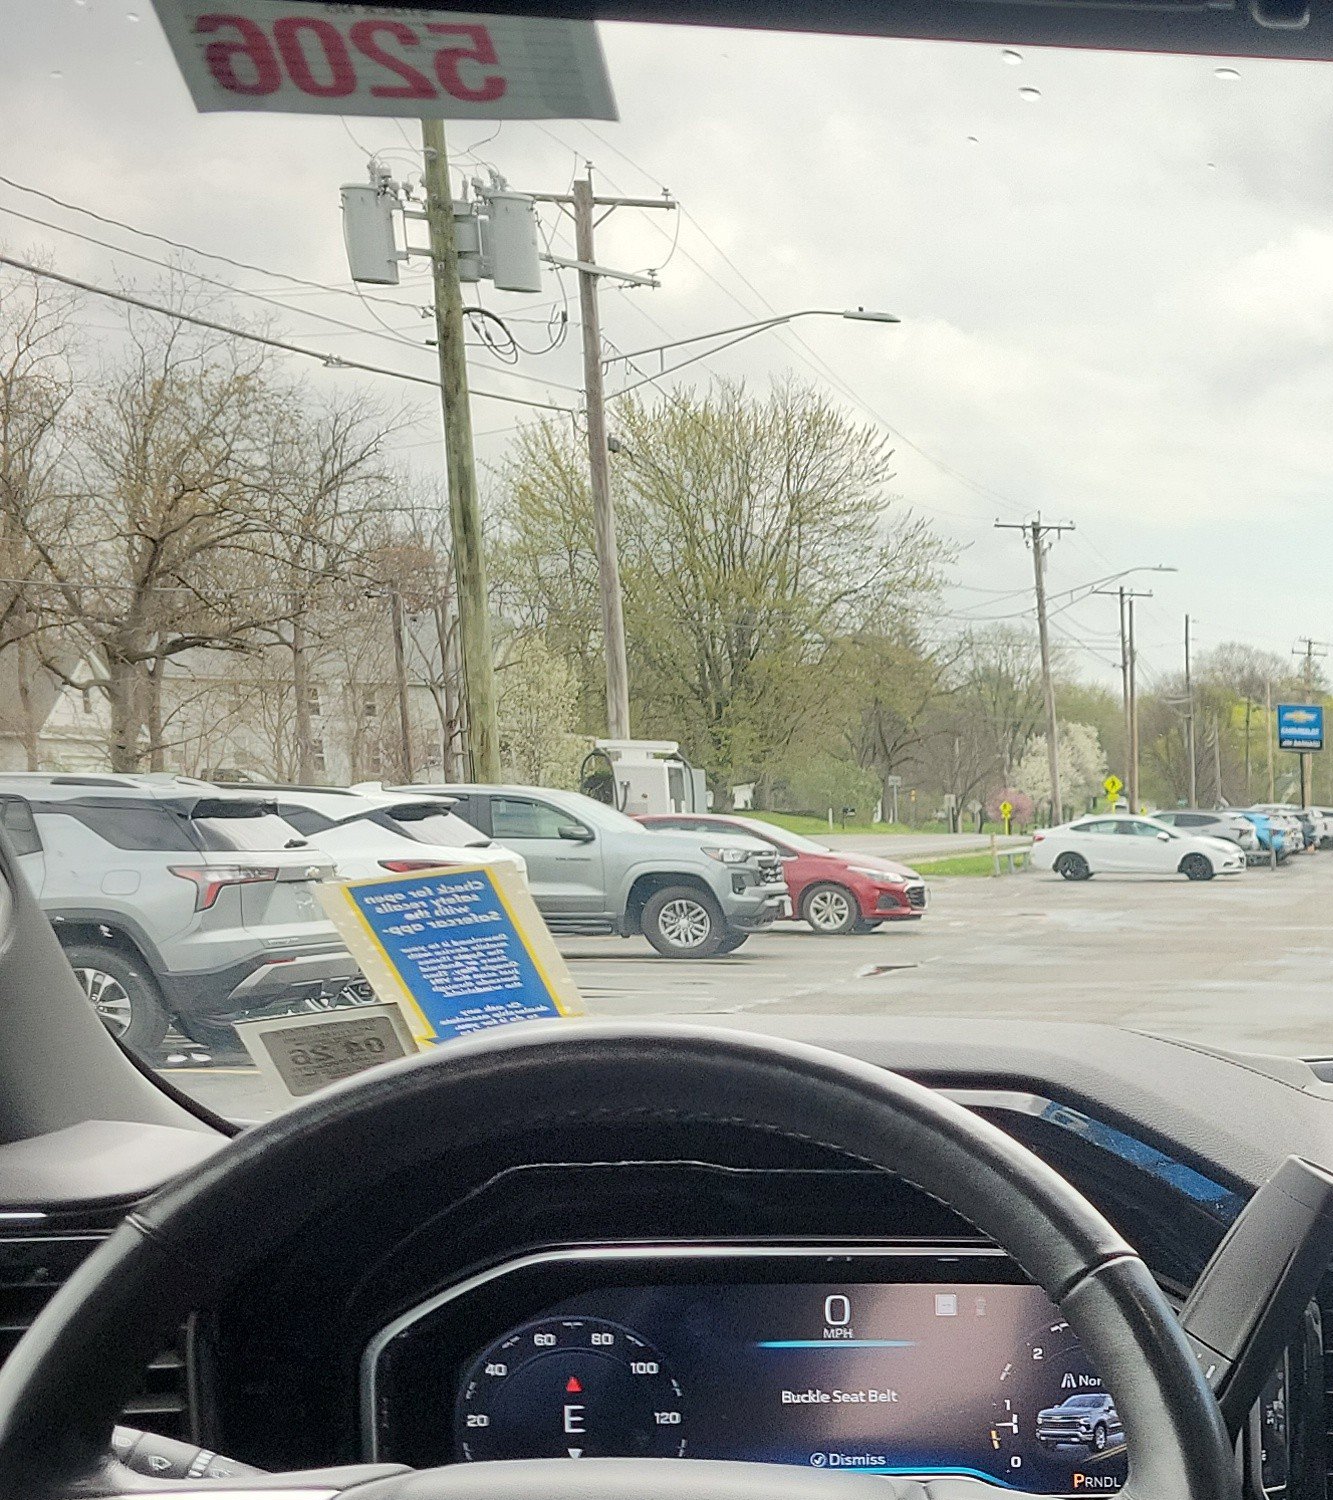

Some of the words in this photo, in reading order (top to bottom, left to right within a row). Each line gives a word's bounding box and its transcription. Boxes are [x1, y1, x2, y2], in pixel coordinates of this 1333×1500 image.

[824, 1294, 851, 1326] 0
[533, 1333, 556, 1347] 60
[591, 1333, 614, 1347] 80
[823, 1327, 853, 1339] MPH
[1032, 1348, 1043, 1360] 2
[484, 1363, 507, 1377] 40
[630, 1361, 659, 1375] 100
[1079, 1375, 1102, 1386] Nor
[781, 1388, 829, 1405] Buckle
[831, 1388, 865, 1405] Seat
[868, 1388, 898, 1405] Belt
[1004, 1399, 1011, 1410] 1
[466, 1414, 489, 1428] 20
[563, 1404, 585, 1434] E
[654, 1411, 681, 1425] 120
[828, 1452, 886, 1467] Dismiss
[1011, 1457, 1021, 1468] 0
